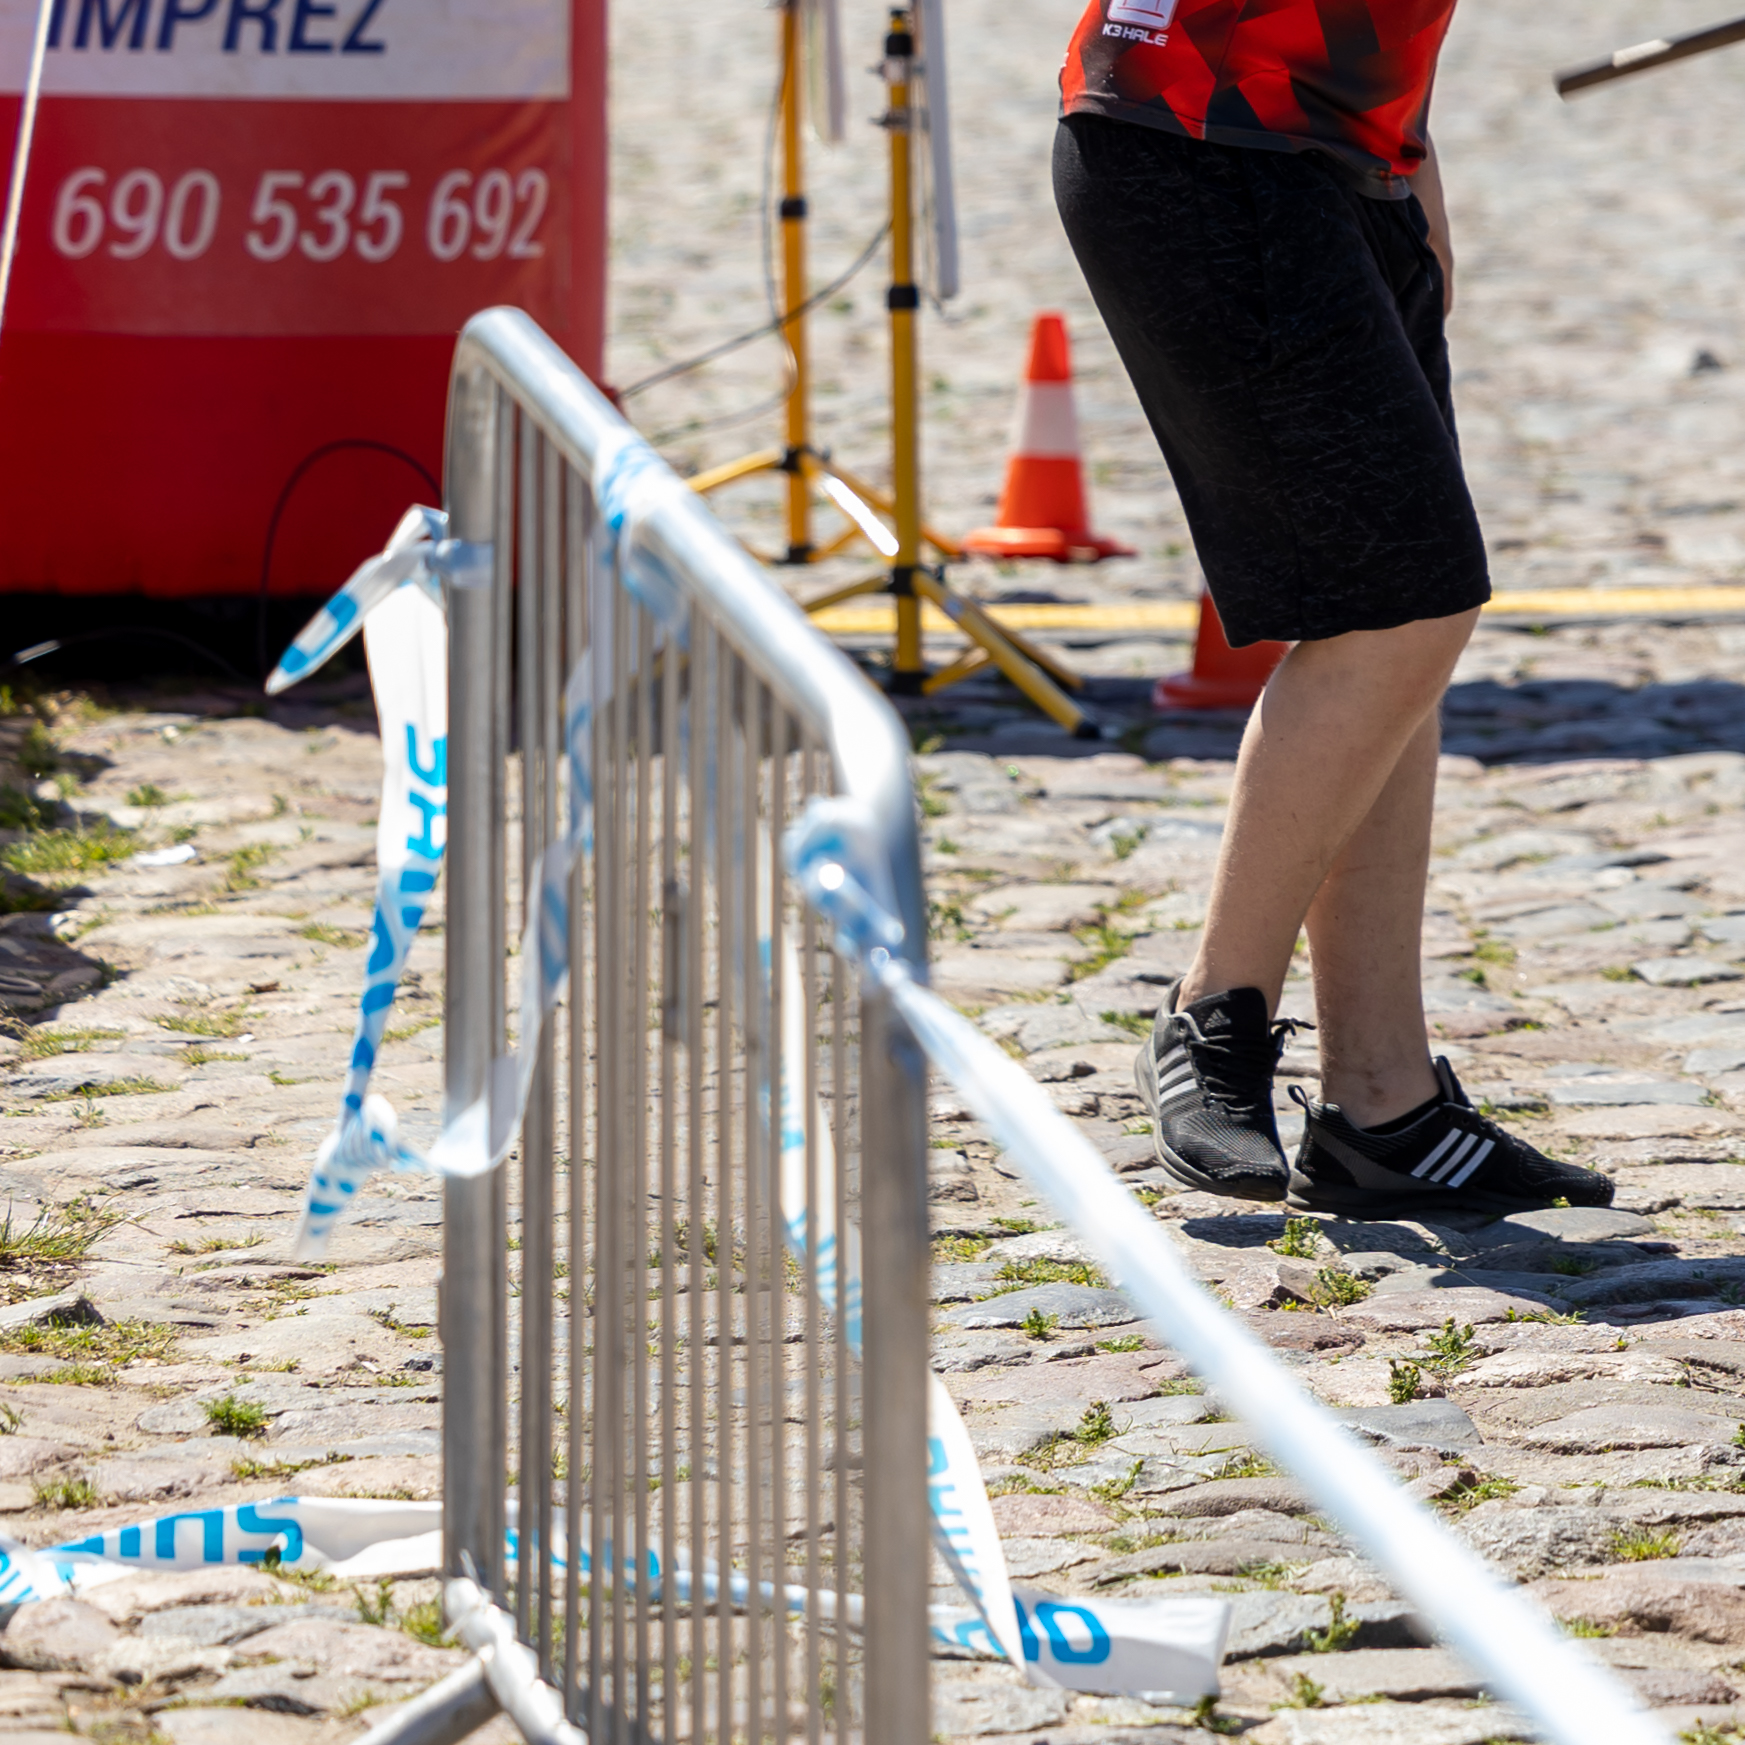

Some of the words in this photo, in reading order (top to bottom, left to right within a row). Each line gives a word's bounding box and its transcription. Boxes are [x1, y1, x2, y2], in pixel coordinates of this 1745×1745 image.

[1102, 22, 1122, 37] K3
[1122, 26, 1170, 48] HALE
[51, 166, 222, 260] 690
[246, 168, 410, 263] 535
[427, 167, 550, 262] 692
